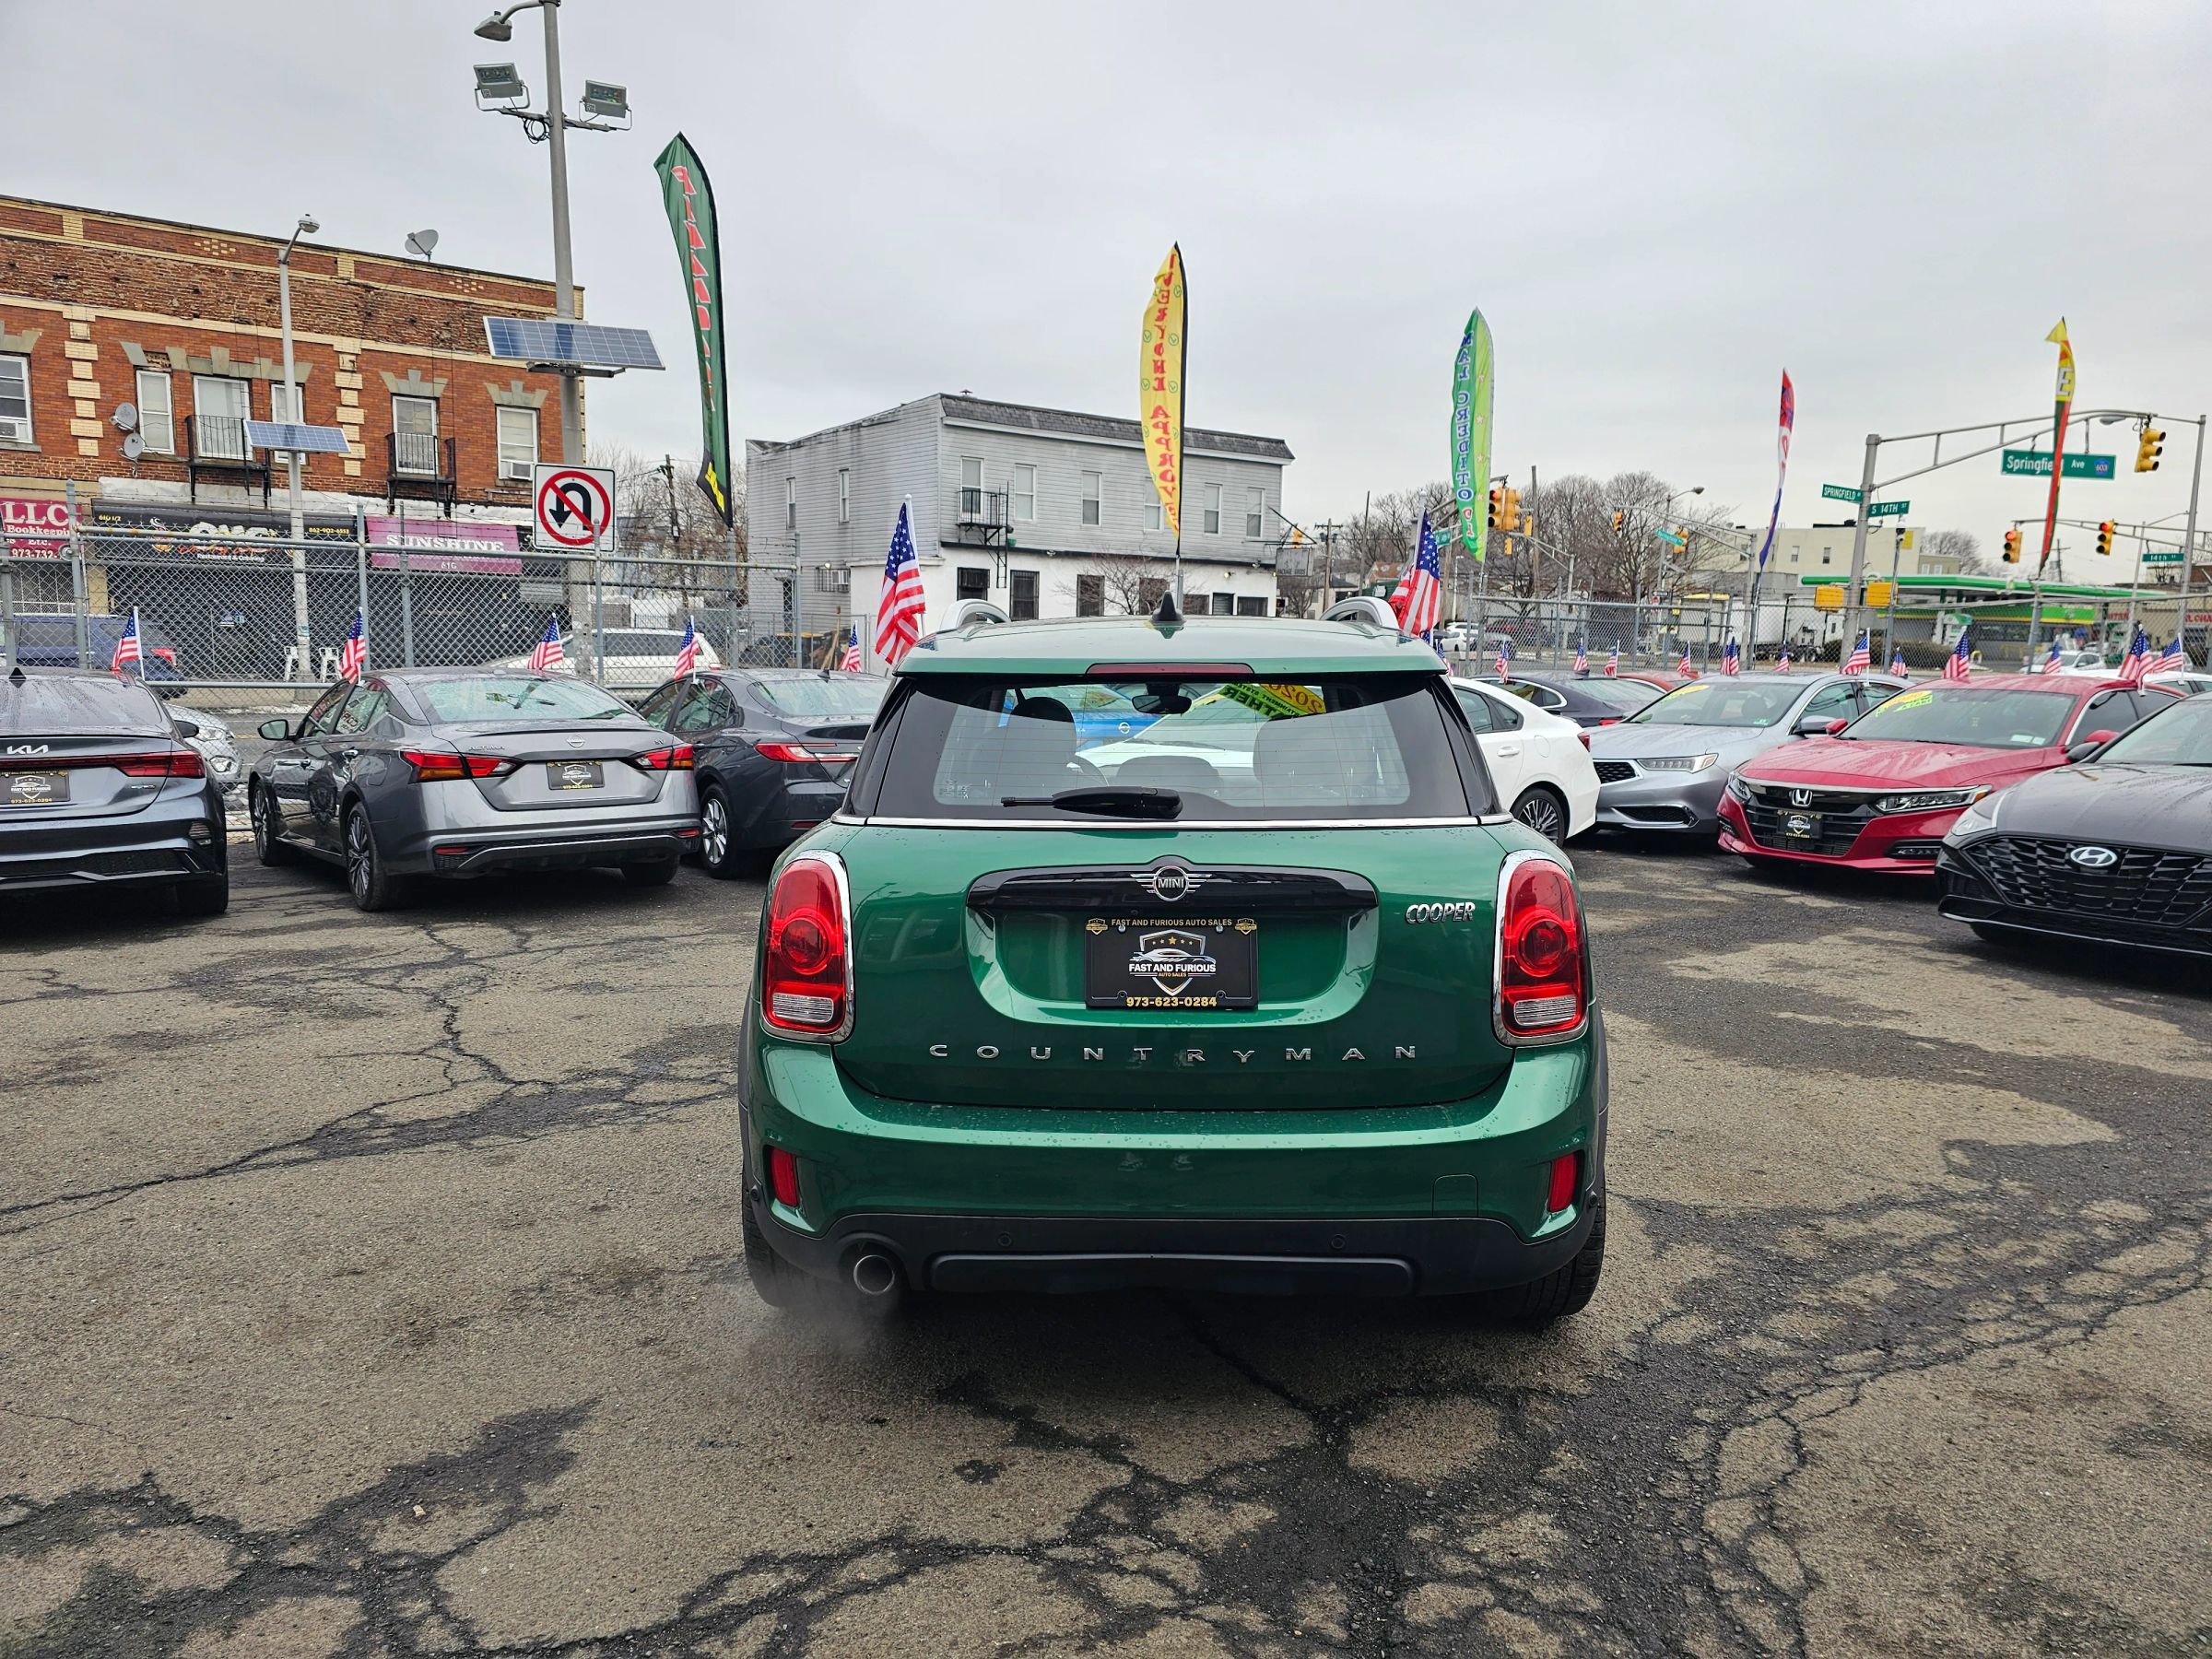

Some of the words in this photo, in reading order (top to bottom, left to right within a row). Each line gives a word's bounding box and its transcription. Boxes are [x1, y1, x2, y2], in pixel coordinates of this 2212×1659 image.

[2006, 455, 2064, 474] Springfie
[2071, 459, 2085, 469] Ave
[1823, 487, 1856, 500] SPRINGFIELD
[3, 501, 69, 526] LLC
[1871, 505, 1877, 514] S
[1881, 503, 1899, 513] 14TH
[386, 535, 504, 551] SUNSHINE
[1158, 877, 1184, 888] MINI
[1406, 901, 1476, 924] COOPER
[1129, 963, 1152, 972] FAST
[1153, 963, 1174, 972] AND
[1175, 963, 1217, 972] FURIOUS
[1126, 996, 1218, 1007] 973-623-0284
[929, 1044, 1417, 1064] COUNTRYMAN
